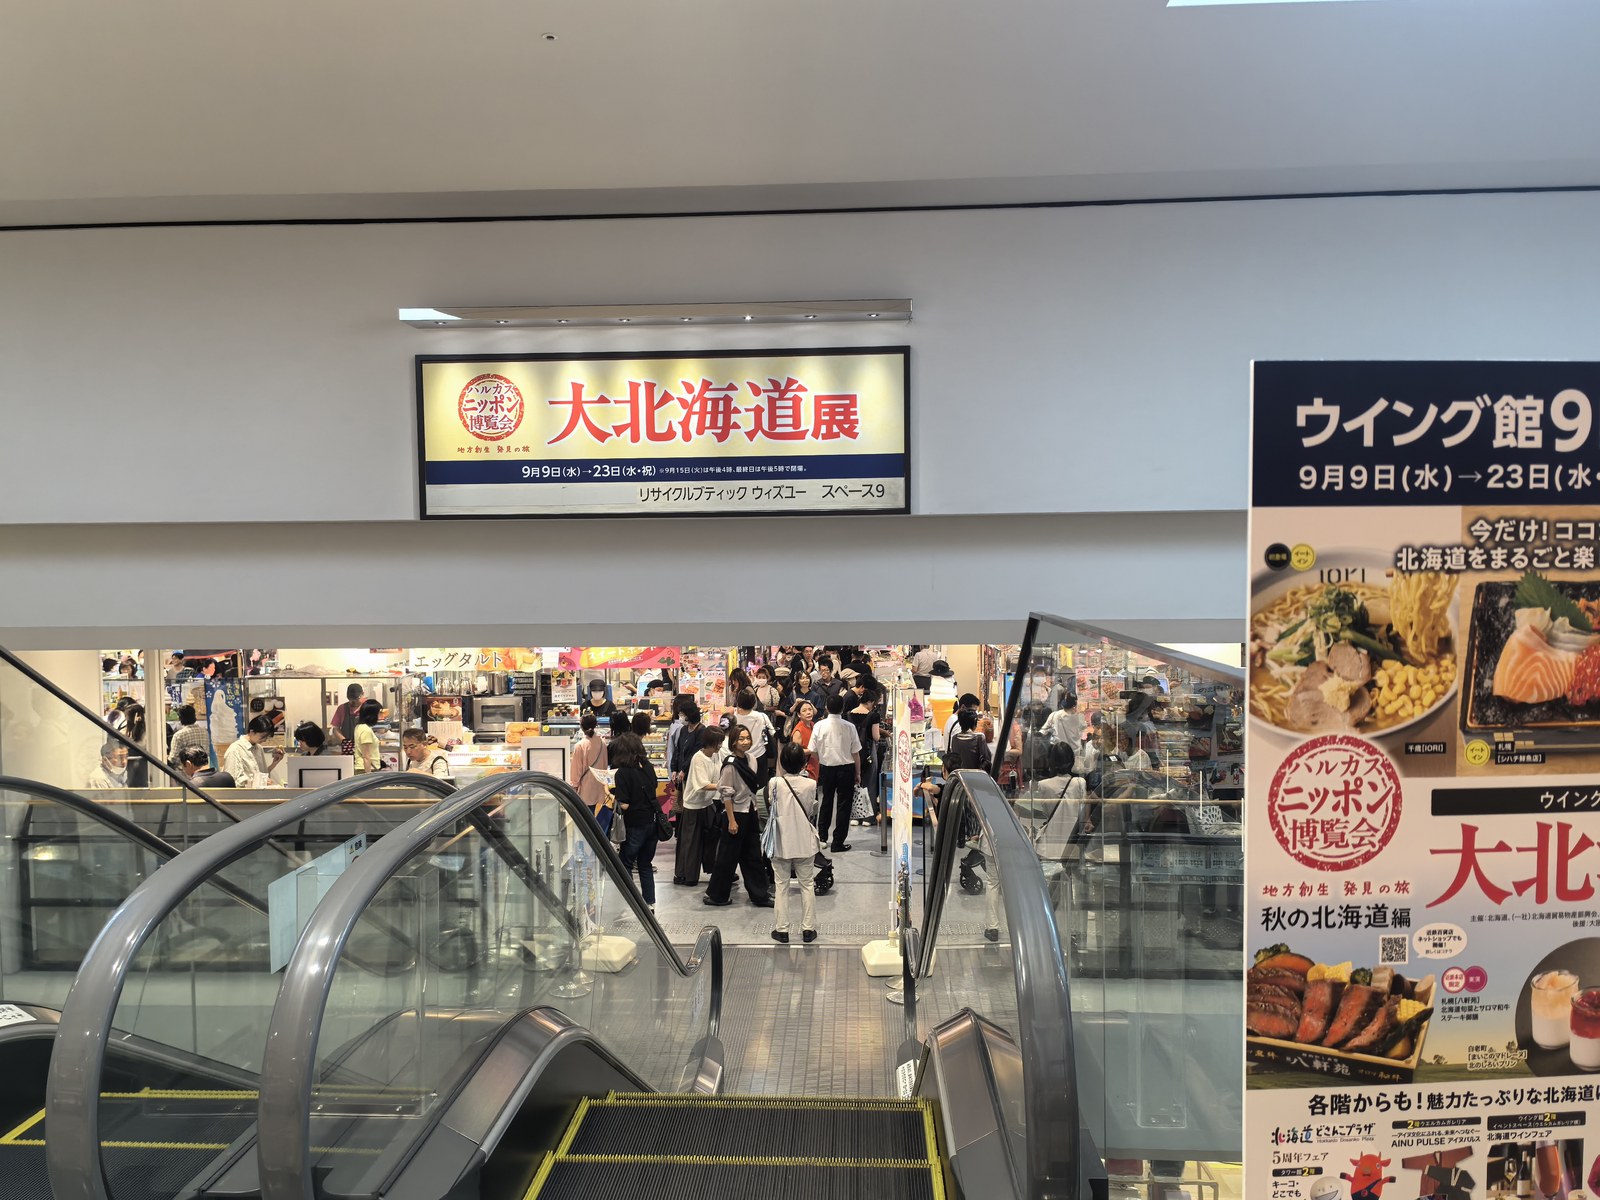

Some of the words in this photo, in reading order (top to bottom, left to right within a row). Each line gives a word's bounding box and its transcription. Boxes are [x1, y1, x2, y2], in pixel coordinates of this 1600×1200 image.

[467, 383, 515, 395] ハルカス
[462, 395, 520, 415] ニッポン
[547, 377, 859, 445] 大北海道展
[470, 413, 514, 432] 博覧会
[639, 486, 748, 502] リサイクルブティック
[752, 485, 806, 500] ウィズユー
[821, 483, 885, 498] スペース9
[1470, 519, 1600, 543] 今だけ!ココ
[415, 651, 502, 669] エッグタルト
[1288, 755, 1383, 778] ハルカス
[1278, 776, 1393, 817] ニッポン
[1289, 818, 1380, 850] 博覧会
[1425, 821, 1600, 909] 大北
[1263, 881, 1329, 898] 地方創生
[1343, 880, 1411, 896] 発見の旅
[1261, 903, 1412, 932] 秋の北海道編
[1308, 1085, 1600, 1115] 各階からも!魅力たっぷりな北海道
[1271, 1125, 1313, 1146] 北海道
[1391, 1139, 1414, 1148] AINU
[1417, 1137, 1446, 1147] PULSE
[1272, 1151, 1329, 1164] 5周年フェア
[1272, 1190, 1301, 1198] どこでも
